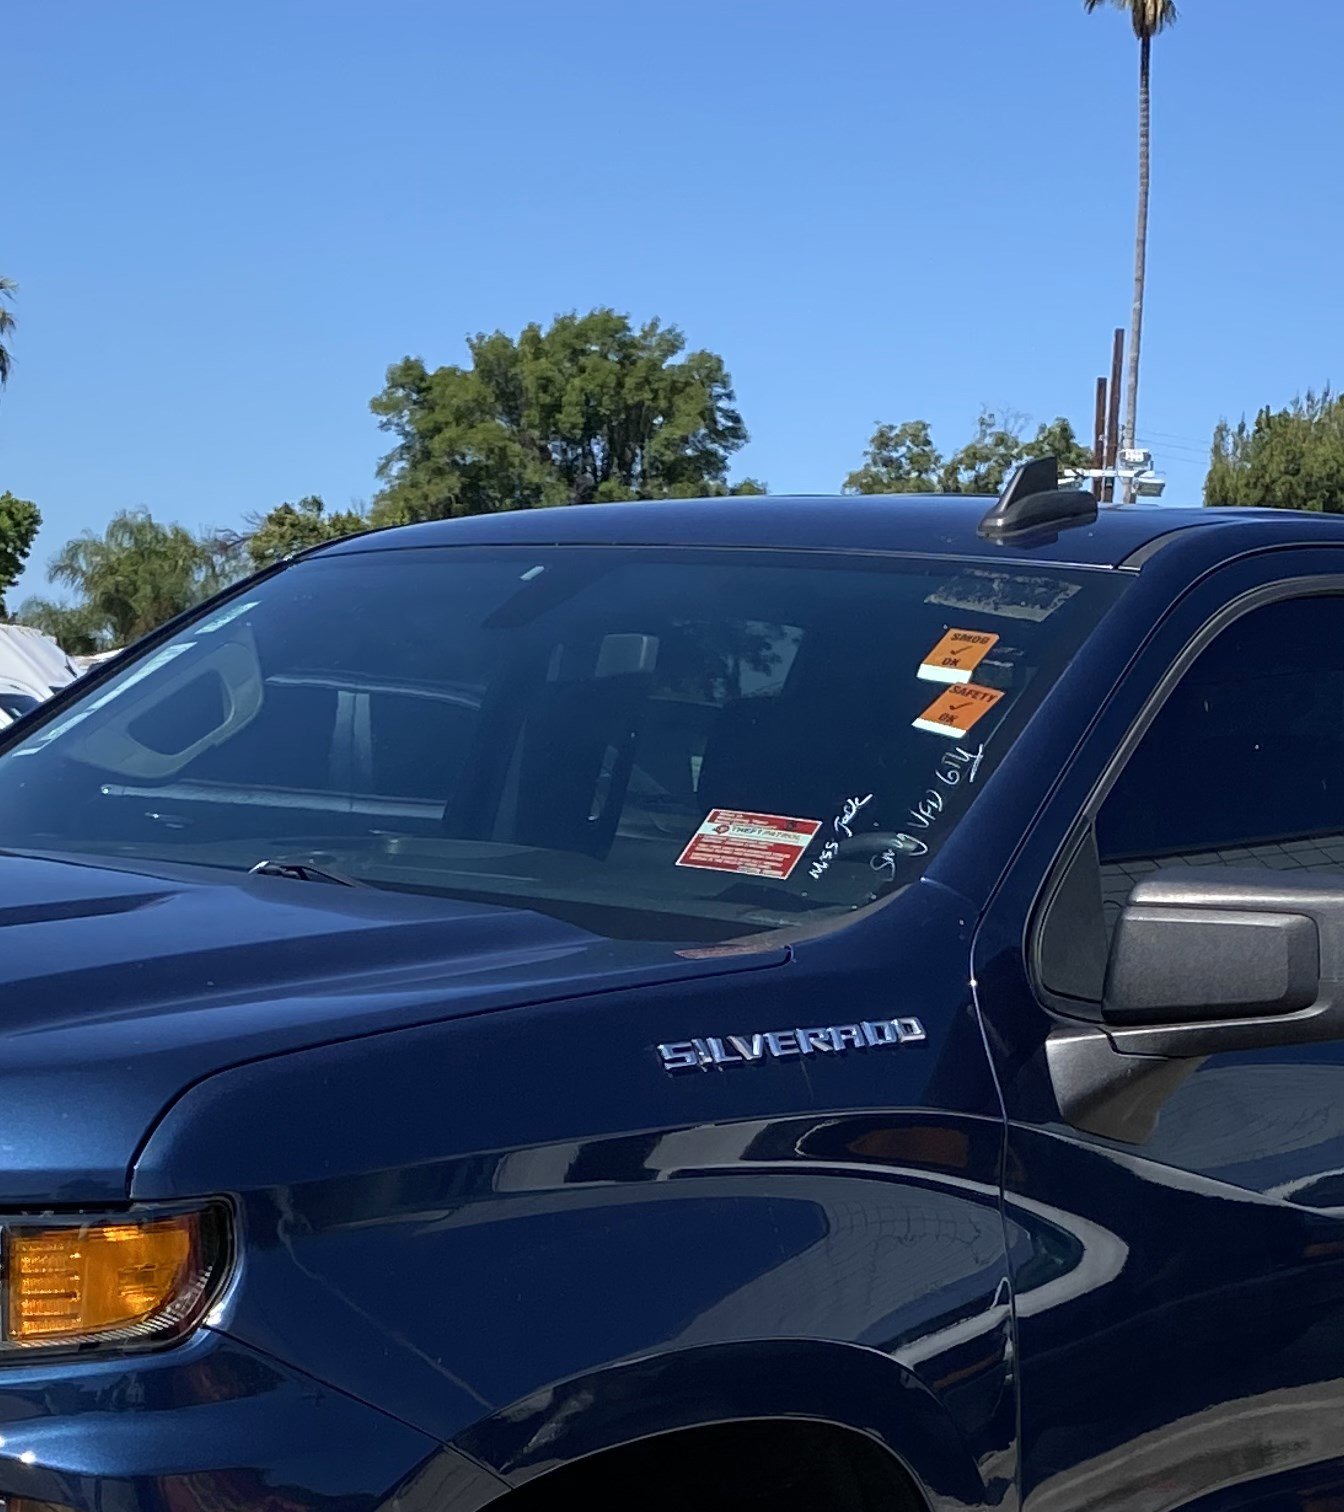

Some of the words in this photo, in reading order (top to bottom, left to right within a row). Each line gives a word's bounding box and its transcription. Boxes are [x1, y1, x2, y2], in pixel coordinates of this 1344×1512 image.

[950, 632, 990, 645] SMOG
[942, 657, 961, 667] OK
[949, 684, 998, 703] SAFETY
[938, 711, 958, 723] OK
[657, 1016, 928, 1070] SILVERADO
